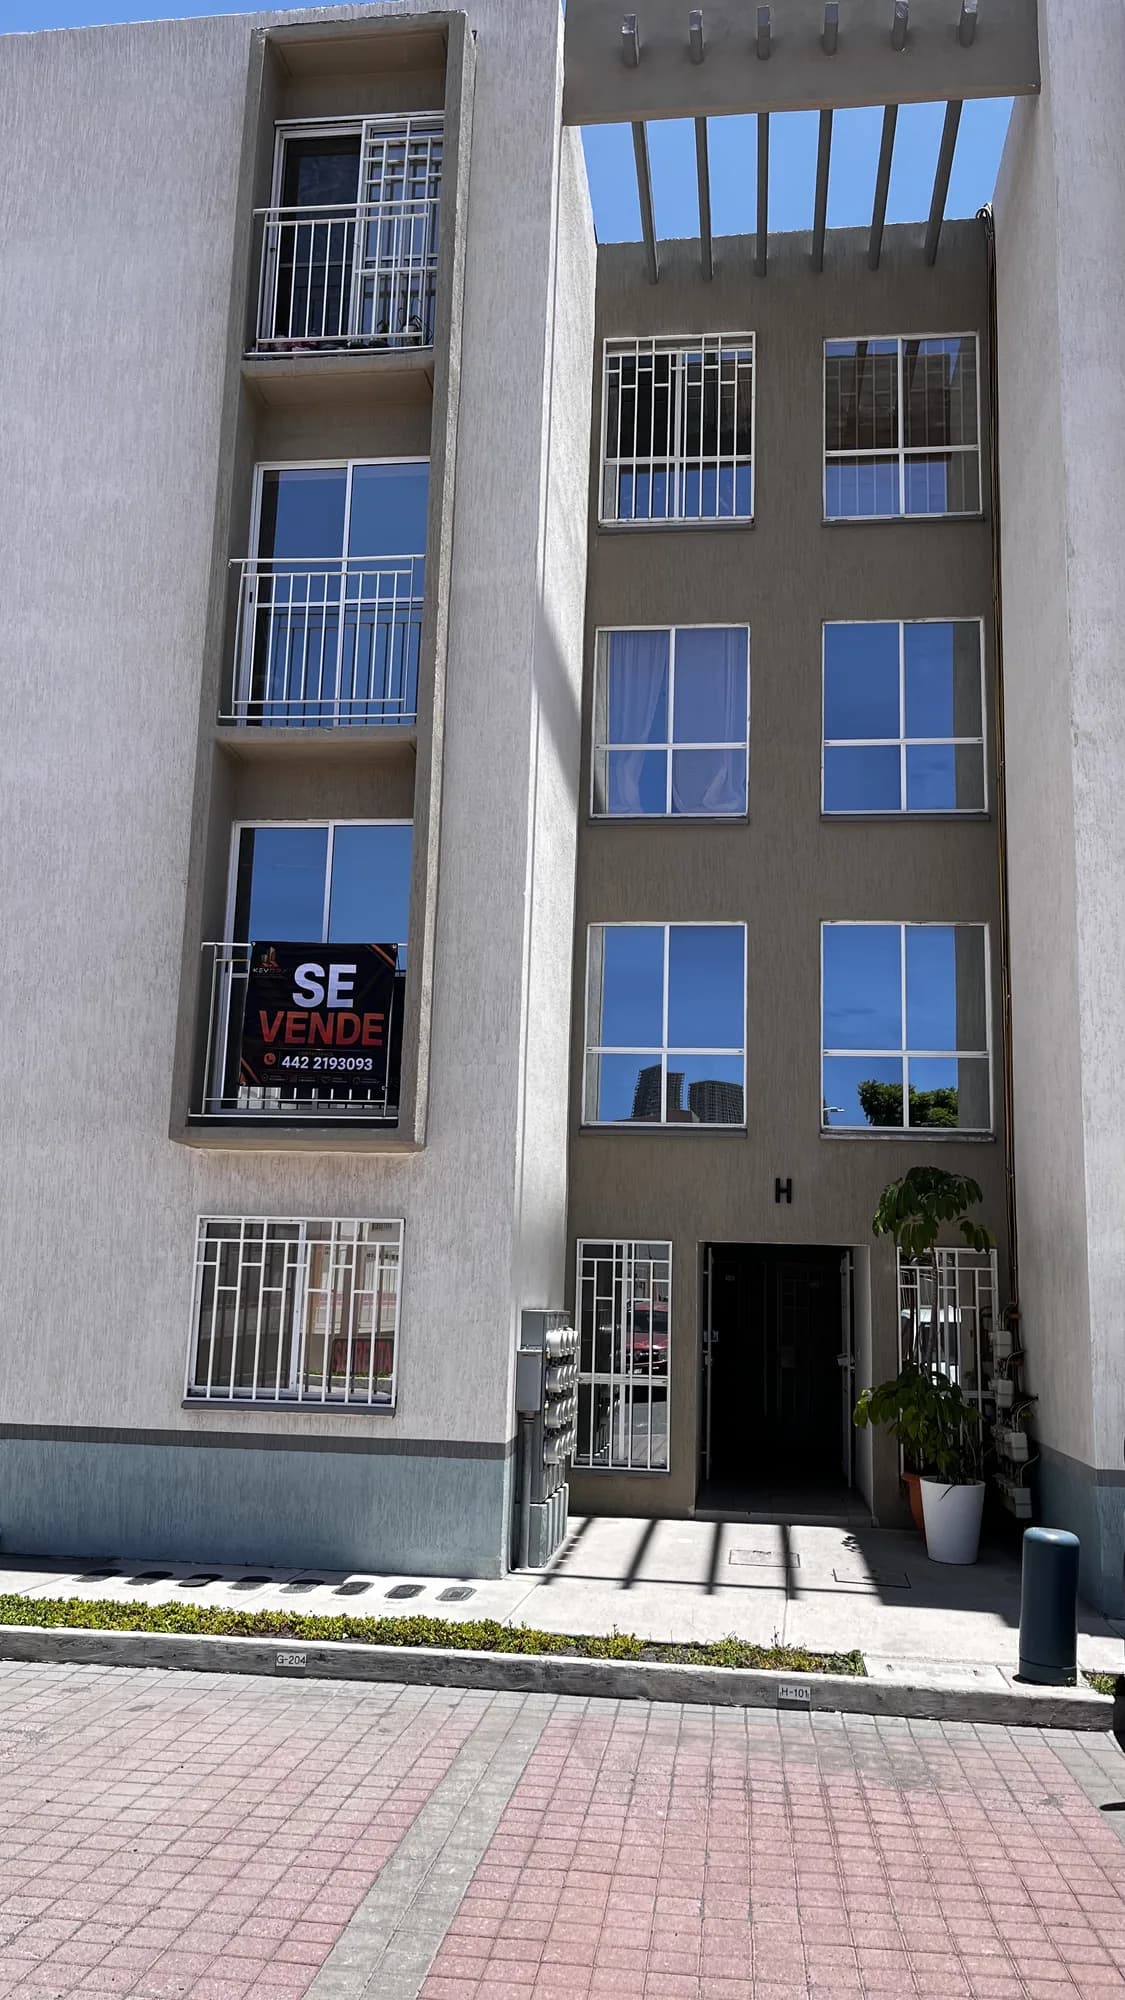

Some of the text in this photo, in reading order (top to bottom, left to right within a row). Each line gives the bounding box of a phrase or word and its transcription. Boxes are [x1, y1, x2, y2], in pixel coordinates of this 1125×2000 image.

[292, 963, 357, 1008] SE
[259, 1010, 385, 1046] VENDE
[281, 1056, 373, 1071] 442 2193093
[775, 1177, 792, 1204] H
[354, 1341, 392, 1373] RETA
[276, 1654, 306, 1665] G-204
[781, 1687, 808, 1698] H-101
